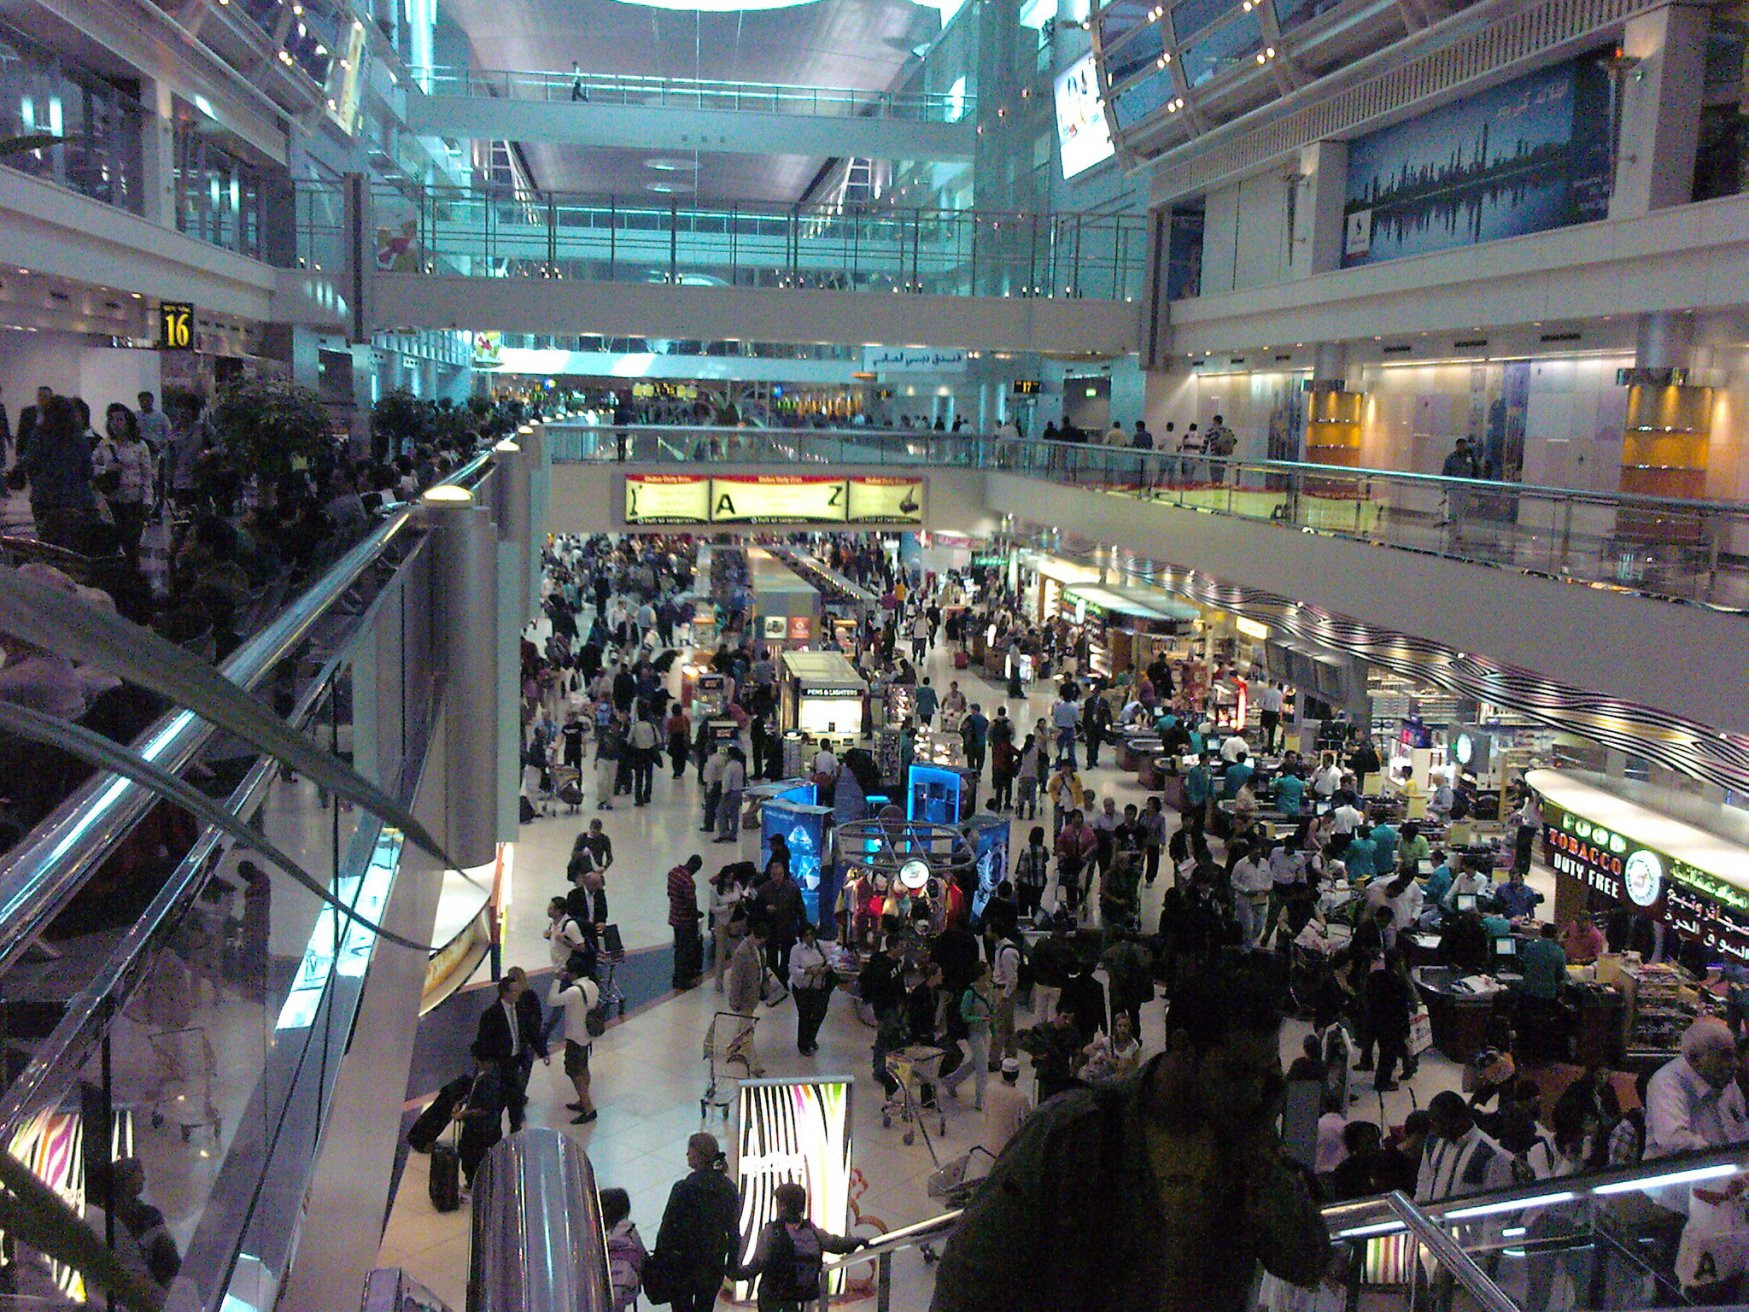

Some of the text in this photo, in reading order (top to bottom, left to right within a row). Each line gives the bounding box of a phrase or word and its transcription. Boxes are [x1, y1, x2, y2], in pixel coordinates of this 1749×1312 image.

[166, 313, 189, 347] 16
[1022, 381, 1033, 394] 17
[715, 493, 736, 514] A
[827, 485, 843, 506] Z
[1562, 812, 1627, 854] FOOD
[1549, 827, 1622, 877] TOBACCO
[1553, 852, 1585, 881] DUTY
[1588, 868, 1620, 900] FREE
